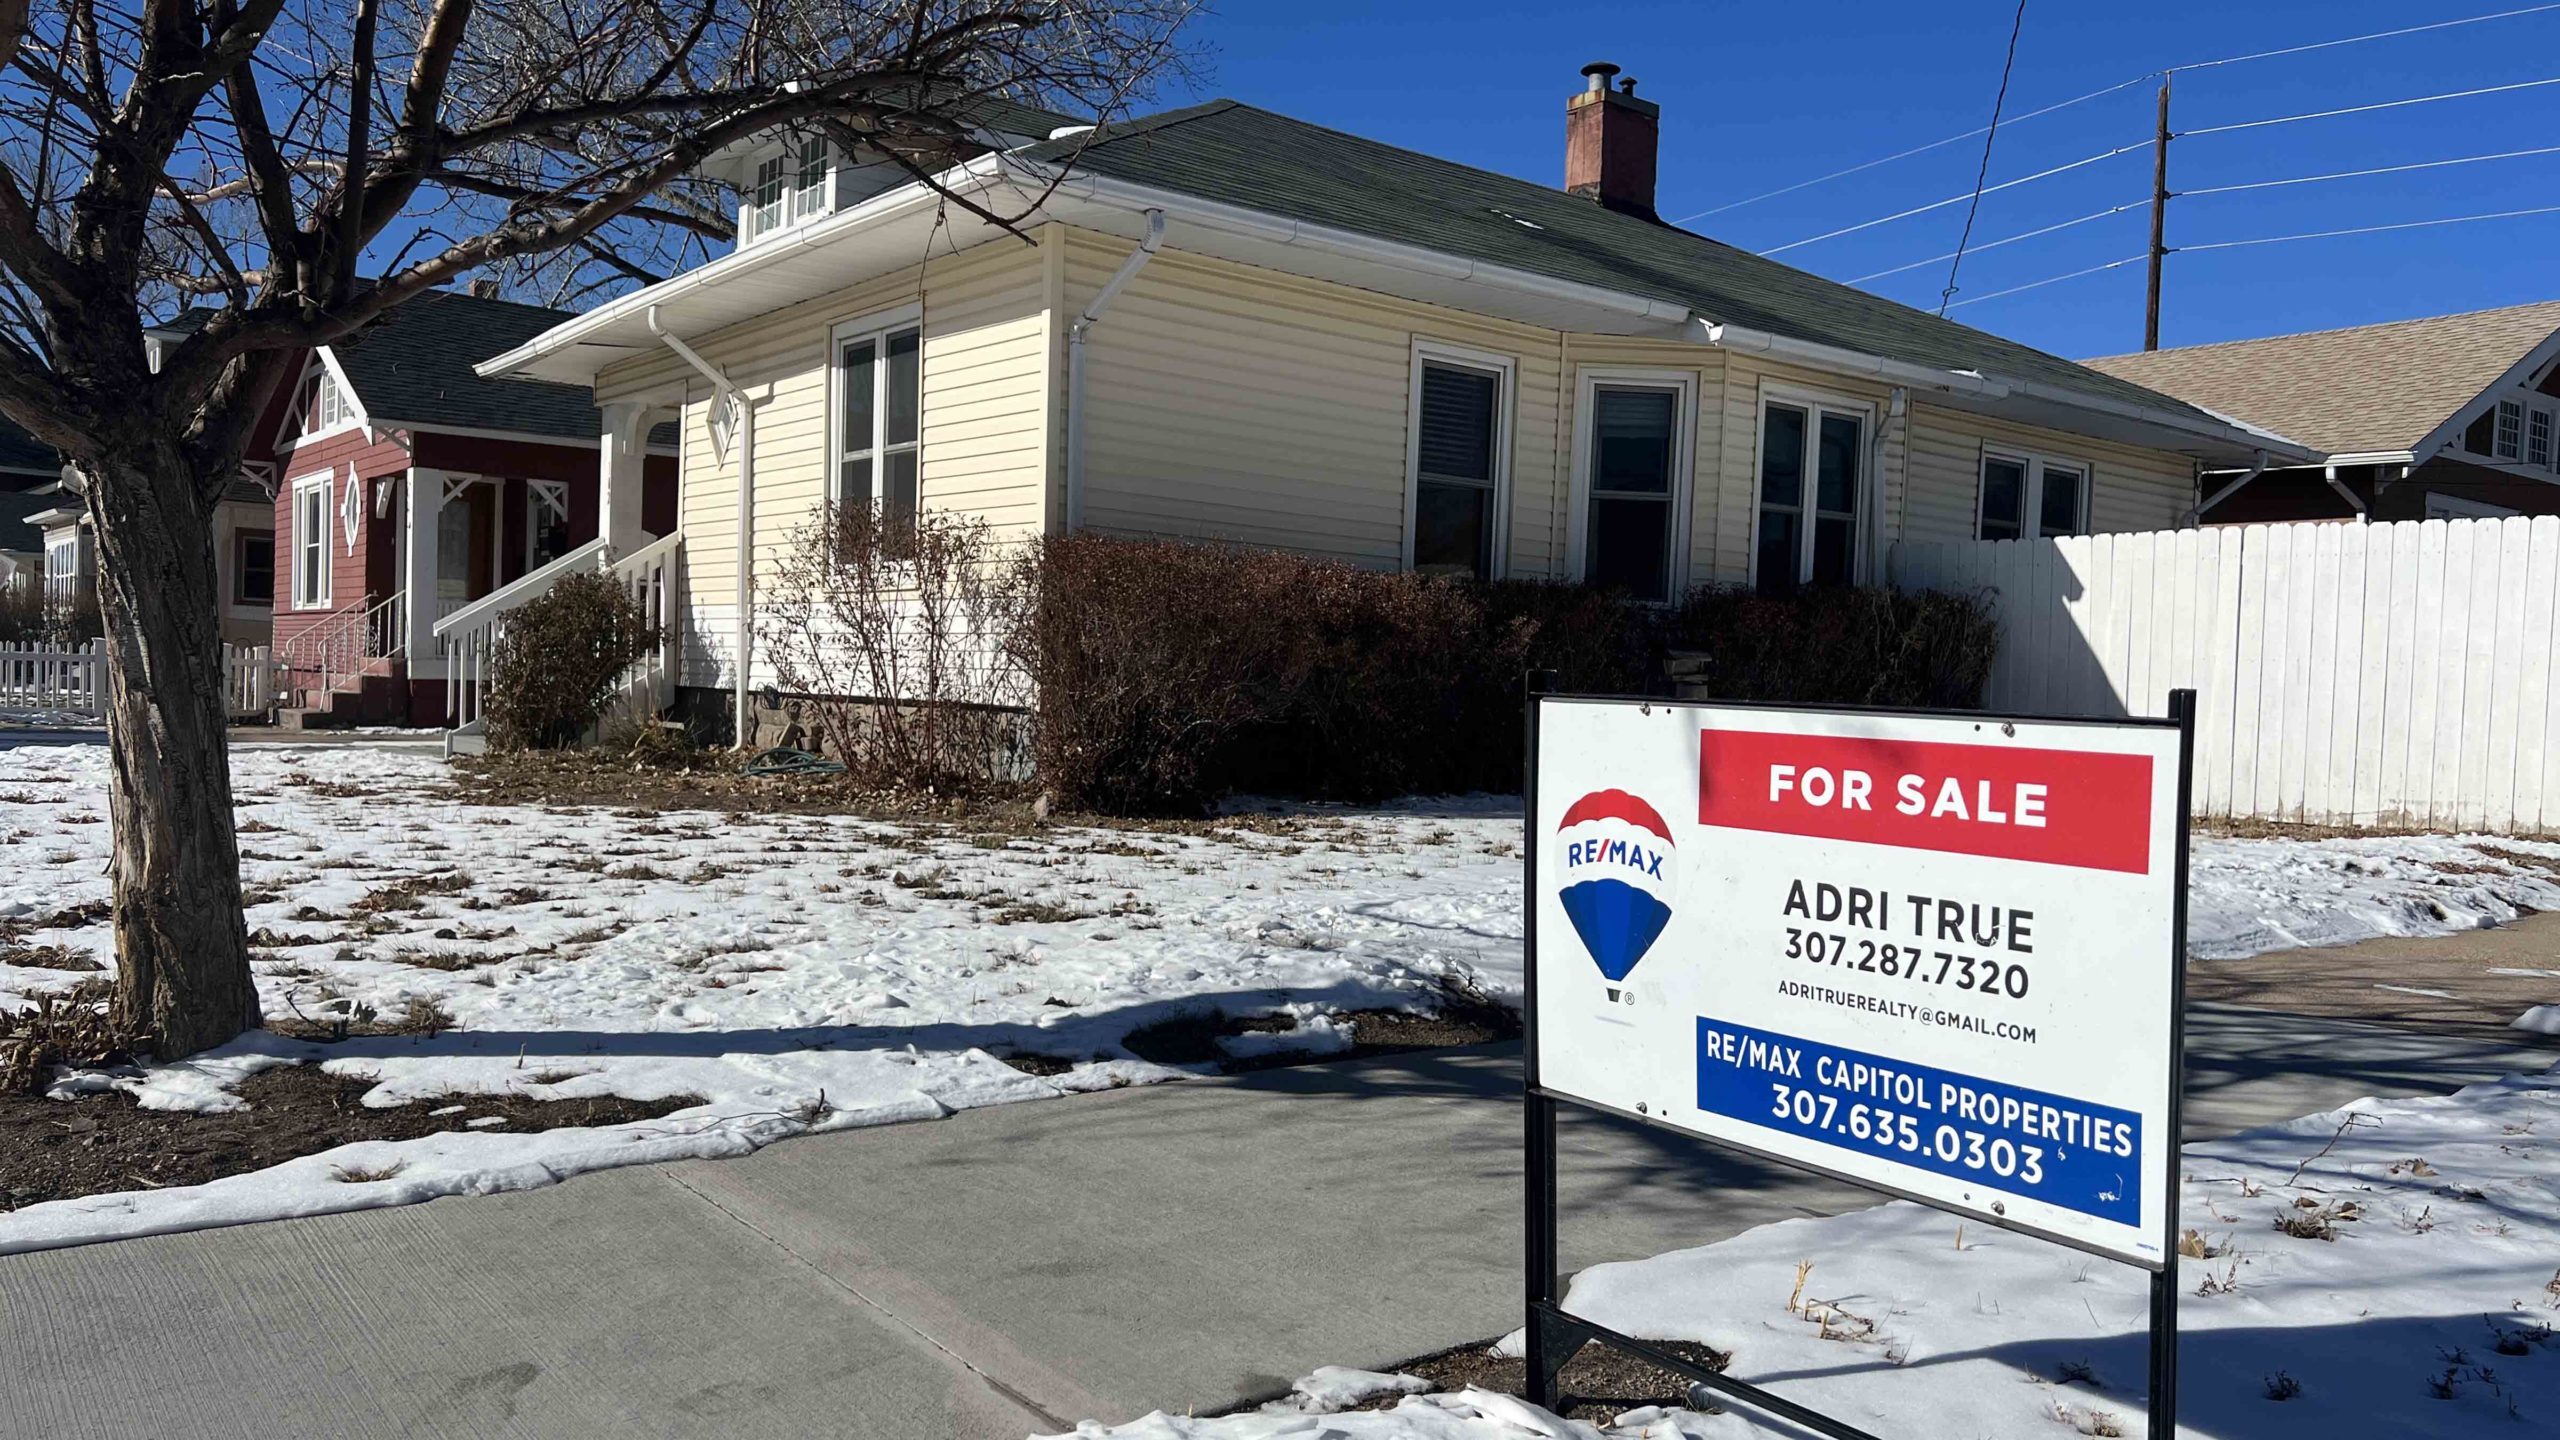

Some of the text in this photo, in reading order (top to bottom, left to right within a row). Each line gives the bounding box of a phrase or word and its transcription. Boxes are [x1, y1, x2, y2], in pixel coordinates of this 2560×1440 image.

[1769, 764, 2048, 828] FOR SALE
[1568, 838, 1664, 881] RE/MAX
[1783, 878, 2034, 954] ADRI TRUE
[1784, 927, 2029, 999] 307.287.7320
[1778, 980, 2036, 1043] ADRITRUEREALTY@GMAIL.COM
[1707, 1030, 2133, 1158] RE/MAX CAPITOL PROPERTIES
[1771, 1083, 2044, 1184] 307.635.0303
